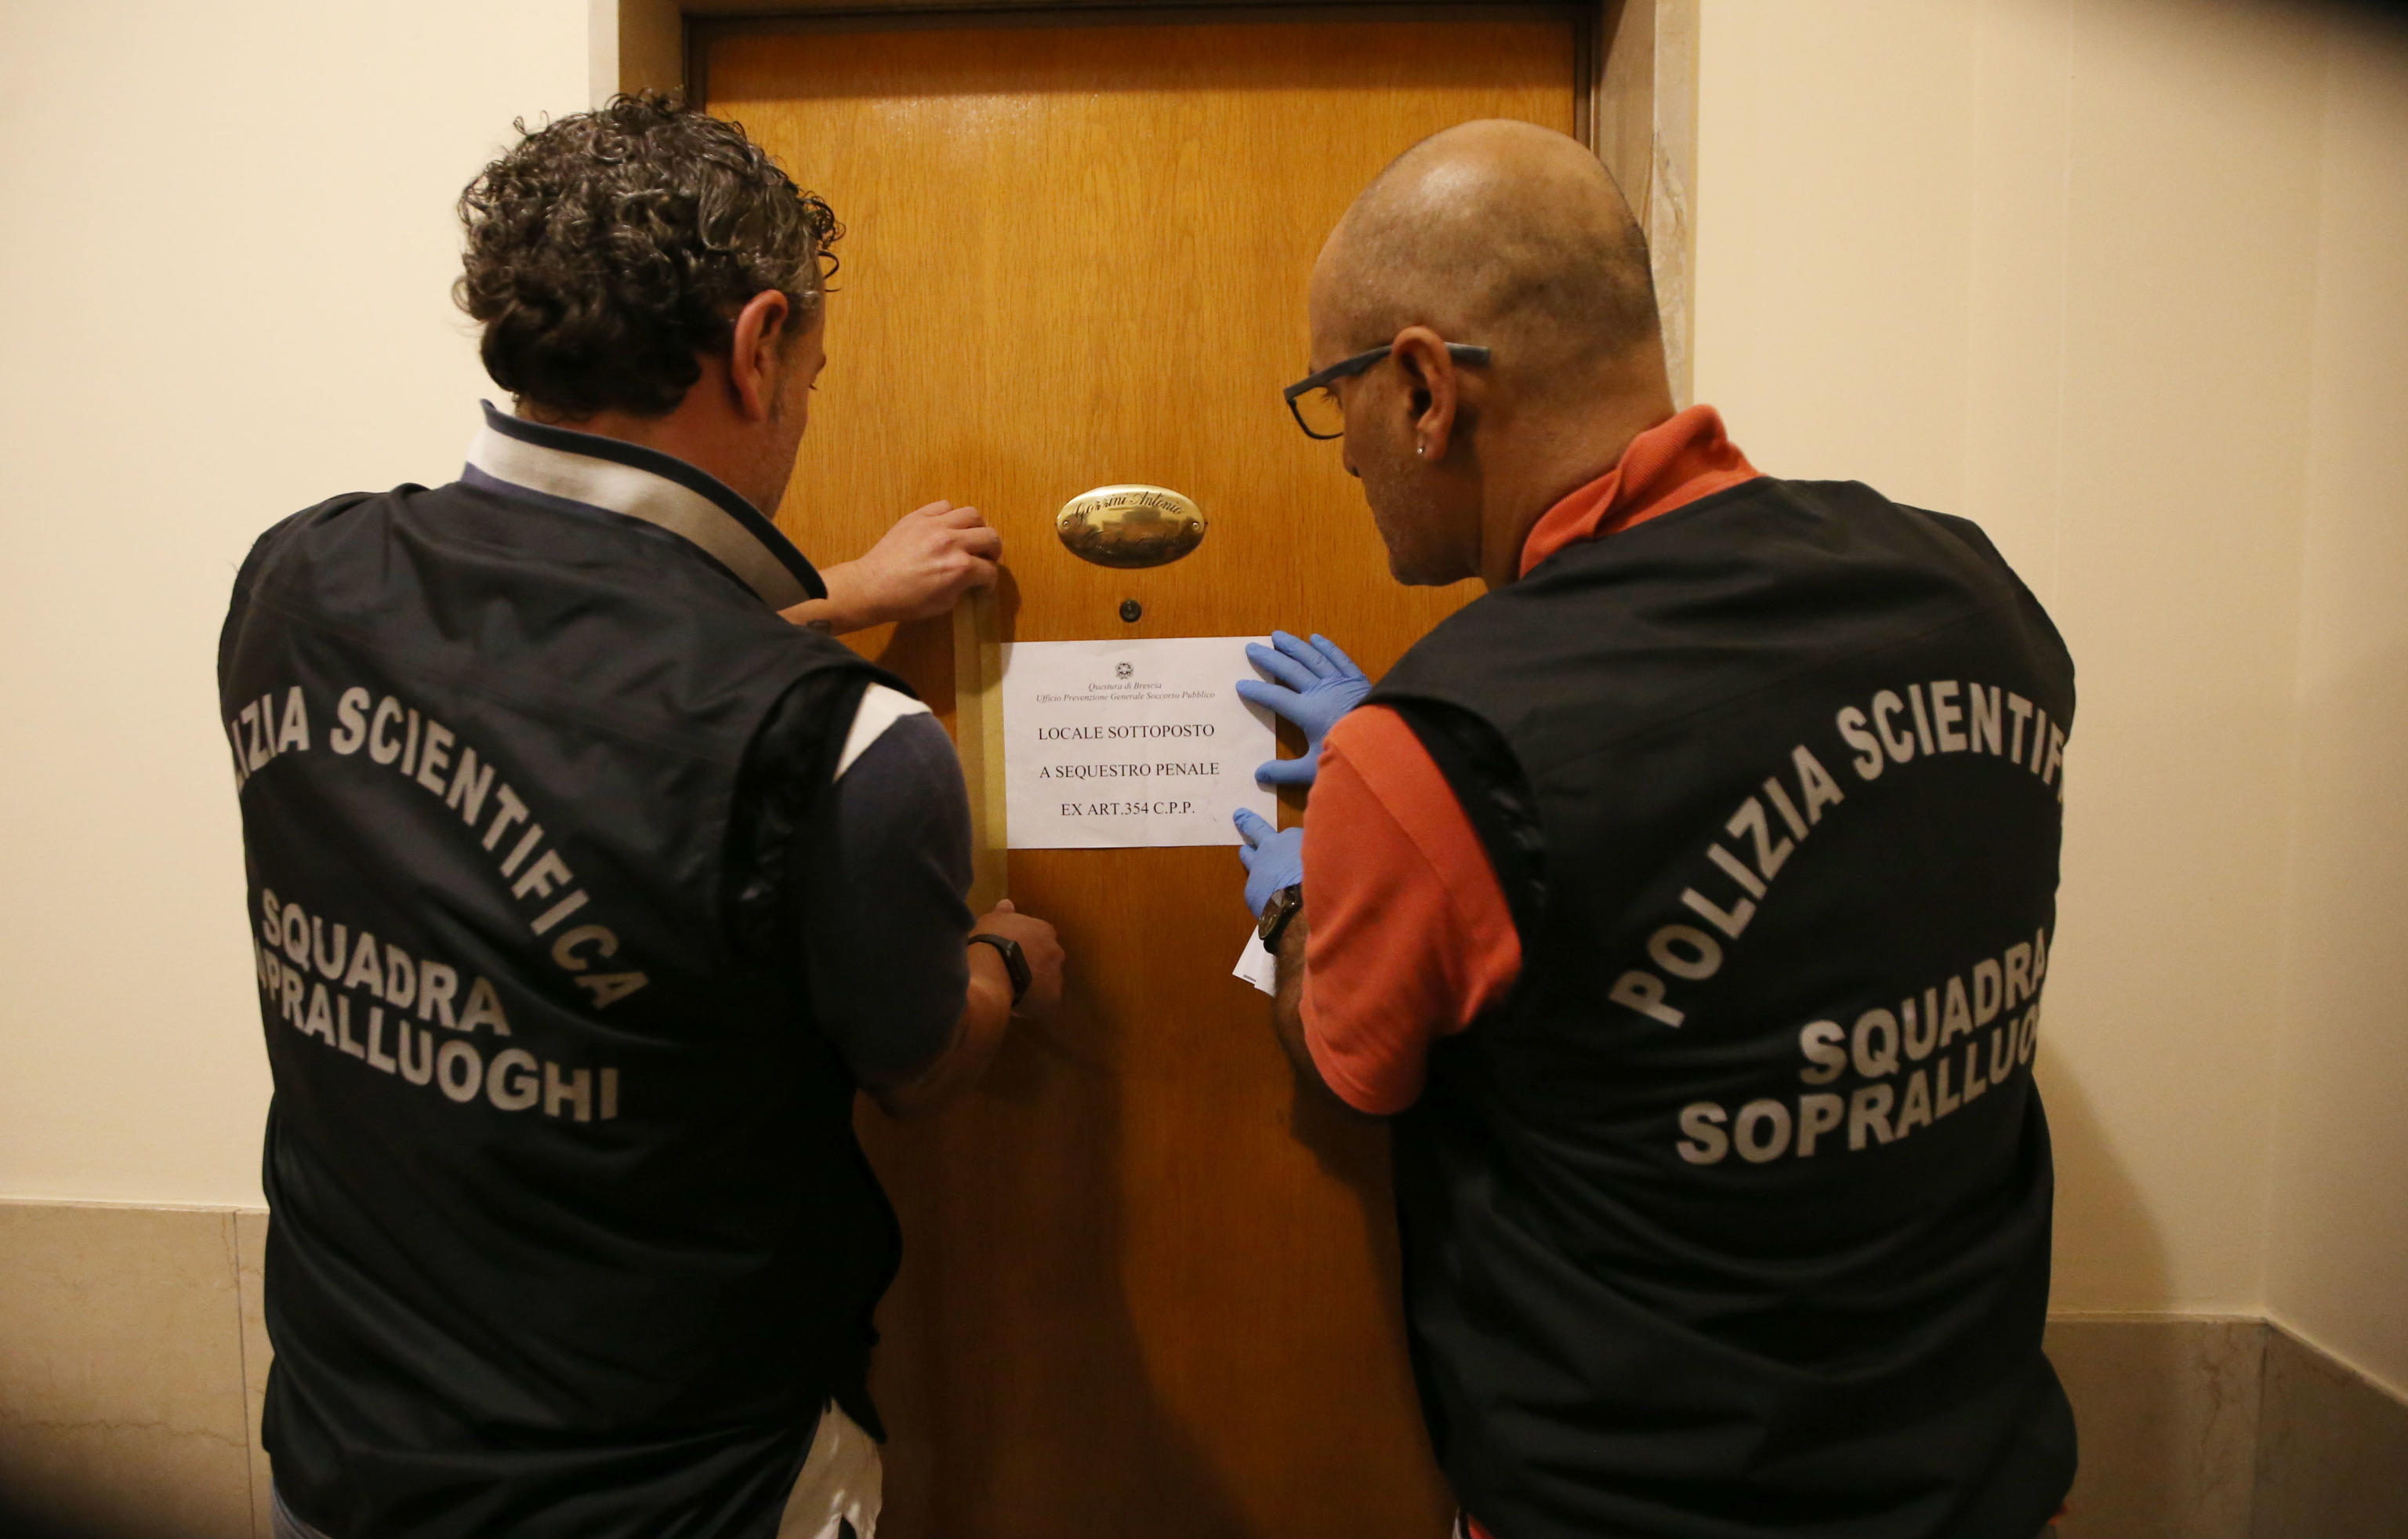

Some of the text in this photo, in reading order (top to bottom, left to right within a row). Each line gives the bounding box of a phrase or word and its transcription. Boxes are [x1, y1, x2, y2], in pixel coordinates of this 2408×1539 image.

[1130, 491, 1184, 514] Antonio
[1036, 694, 1061, 703] Ufficio
[1064, 693, 1108, 702] Prevenzione
[1147, 691, 1180, 700] Soccorso
[1182, 690, 1215, 699] Pubblico
[1088, 683, 1122, 691] Questura
[1039, 724, 1215, 740] LOCALE SOTTOPOSTO
[1039, 762, 1220, 780] A SEQUESTRO PENALE
[1061, 801, 1195, 816] EX ART.354 C.P.P.
[231, 685, 650, 1010] IZIA SCIENTIFICA
[1608, 679, 2065, 1029] POLIZIA SCIENTIF
[262, 887, 512, 1036] SQUADRA
[1798, 927, 2047, 1086] SQUADRA
